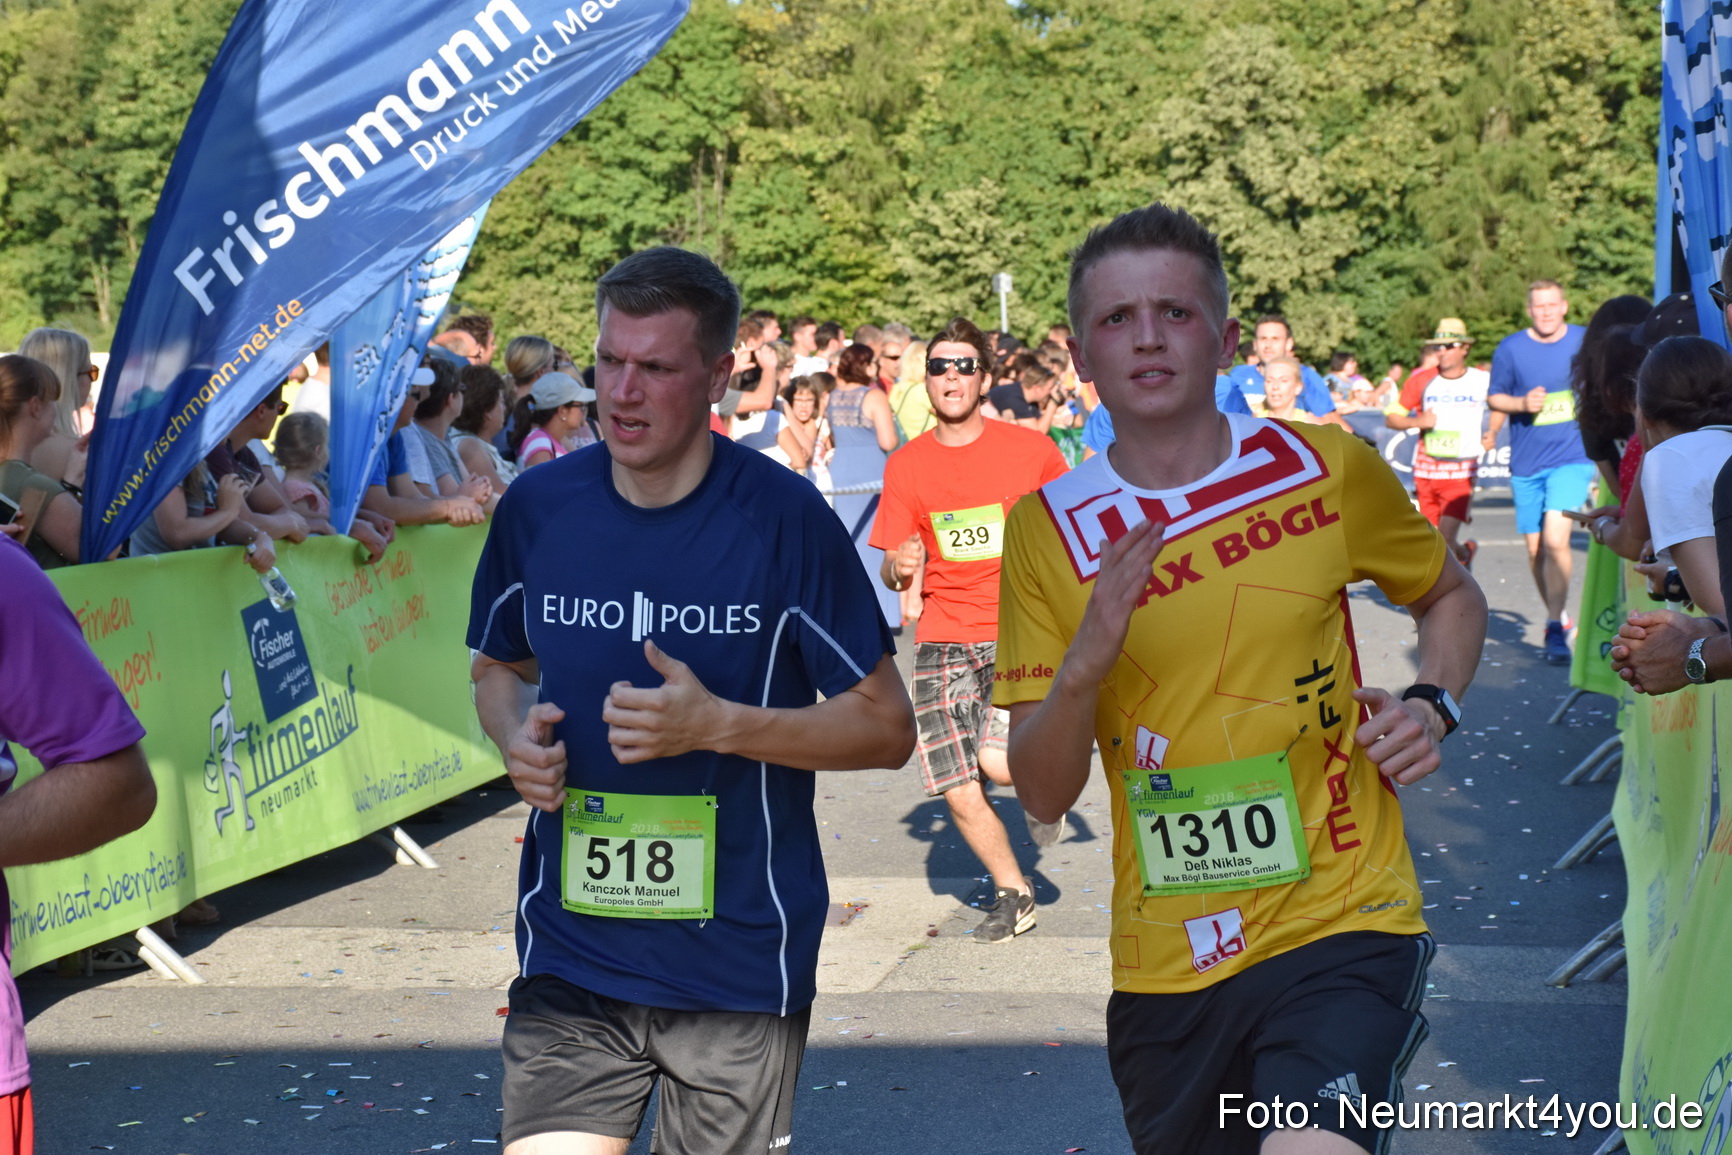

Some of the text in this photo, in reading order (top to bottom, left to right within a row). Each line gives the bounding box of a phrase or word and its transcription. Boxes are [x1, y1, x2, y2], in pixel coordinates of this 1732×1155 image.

[409, 91, 498, 171] Druck
[496, 34, 557, 96] und
[173, 0, 532, 316] Frischmann
[102, 298, 305, 524] www.frischmann-net.de
[949, 526, 990, 548] 239
[1136, 496, 1341, 610] AX BÖGL
[543, 594, 762, 635] EURO POLES
[258, 629, 295, 661] Fischer
[245, 663, 360, 790] firmenlauf
[260, 766, 320, 819] neumarkt
[1143, 786, 1195, 800] firmenlauf
[1203, 791, 1235, 806] 2018
[577, 808, 625, 824] firmenlauf
[629, 823, 660, 835] 2018
[1150, 803, 1277, 860] 1310
[585, 836, 676, 885] 518
[1163, 873, 1181, 883] Max
[1182, 871, 1201, 884] Bögl
[1202, 869, 1251, 882] Bauservice
[1253, 862, 1282, 876] GmbH
[1184, 855, 1253, 872] Deß Niklas
[582, 881, 681, 898] Kanczok Manuel
[594, 895, 665, 907] Europoles GmbH
